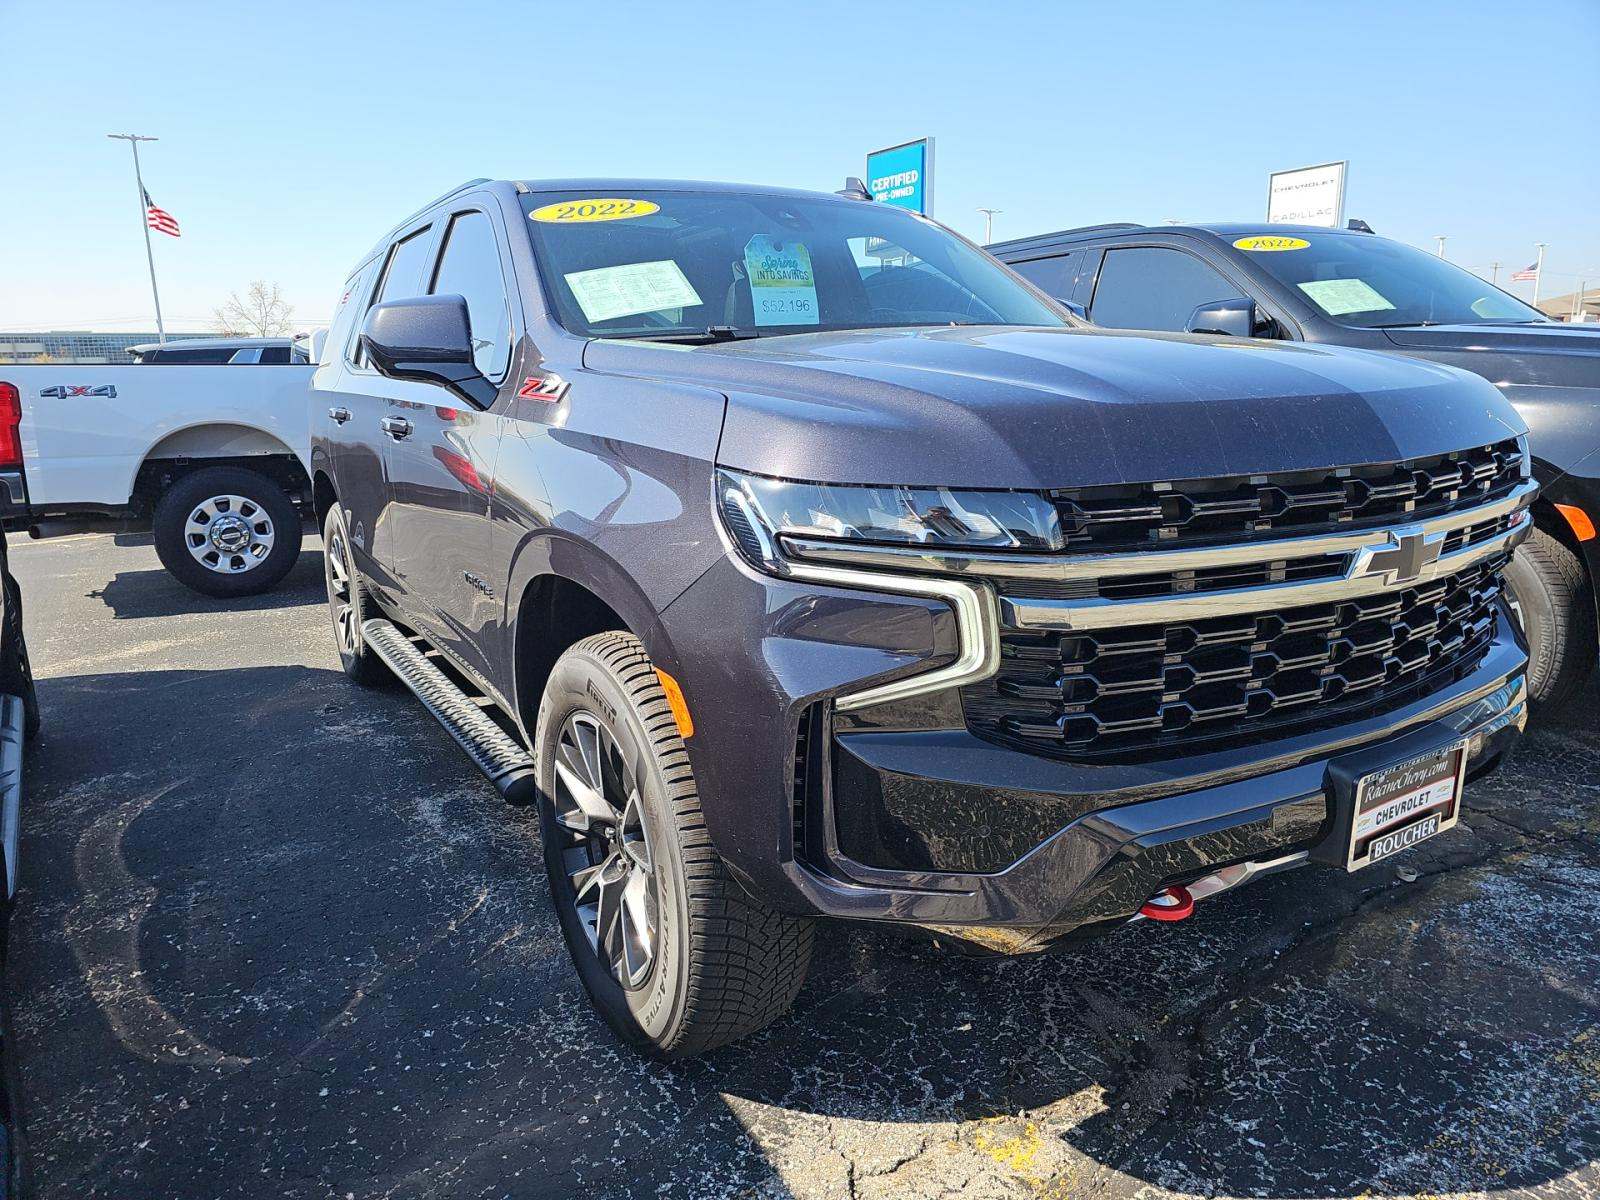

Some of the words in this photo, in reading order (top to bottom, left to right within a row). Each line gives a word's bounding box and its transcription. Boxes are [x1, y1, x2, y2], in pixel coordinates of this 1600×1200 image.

[872, 169, 919, 192] CERTIFIED
[1274, 179, 1335, 193] CHEVROLET
[876, 186, 915, 203] PRE-OWNED
[556, 202, 636, 219] 2022
[1273, 207, 1333, 222] CADILLAC
[1248, 239, 1297, 249] 2022
[761, 254, 799, 273] Spring
[756, 270, 776, 281] INTO
[777, 270, 810, 281] SAVINGS
[762, 299, 810, 313] $52,196
[517, 375, 572, 404] Z71
[1364, 760, 1449, 803] RacineChevy.com
[1375, 791, 1431, 826] CHEVROLET
[1374, 818, 1436, 858] BOUCHER
